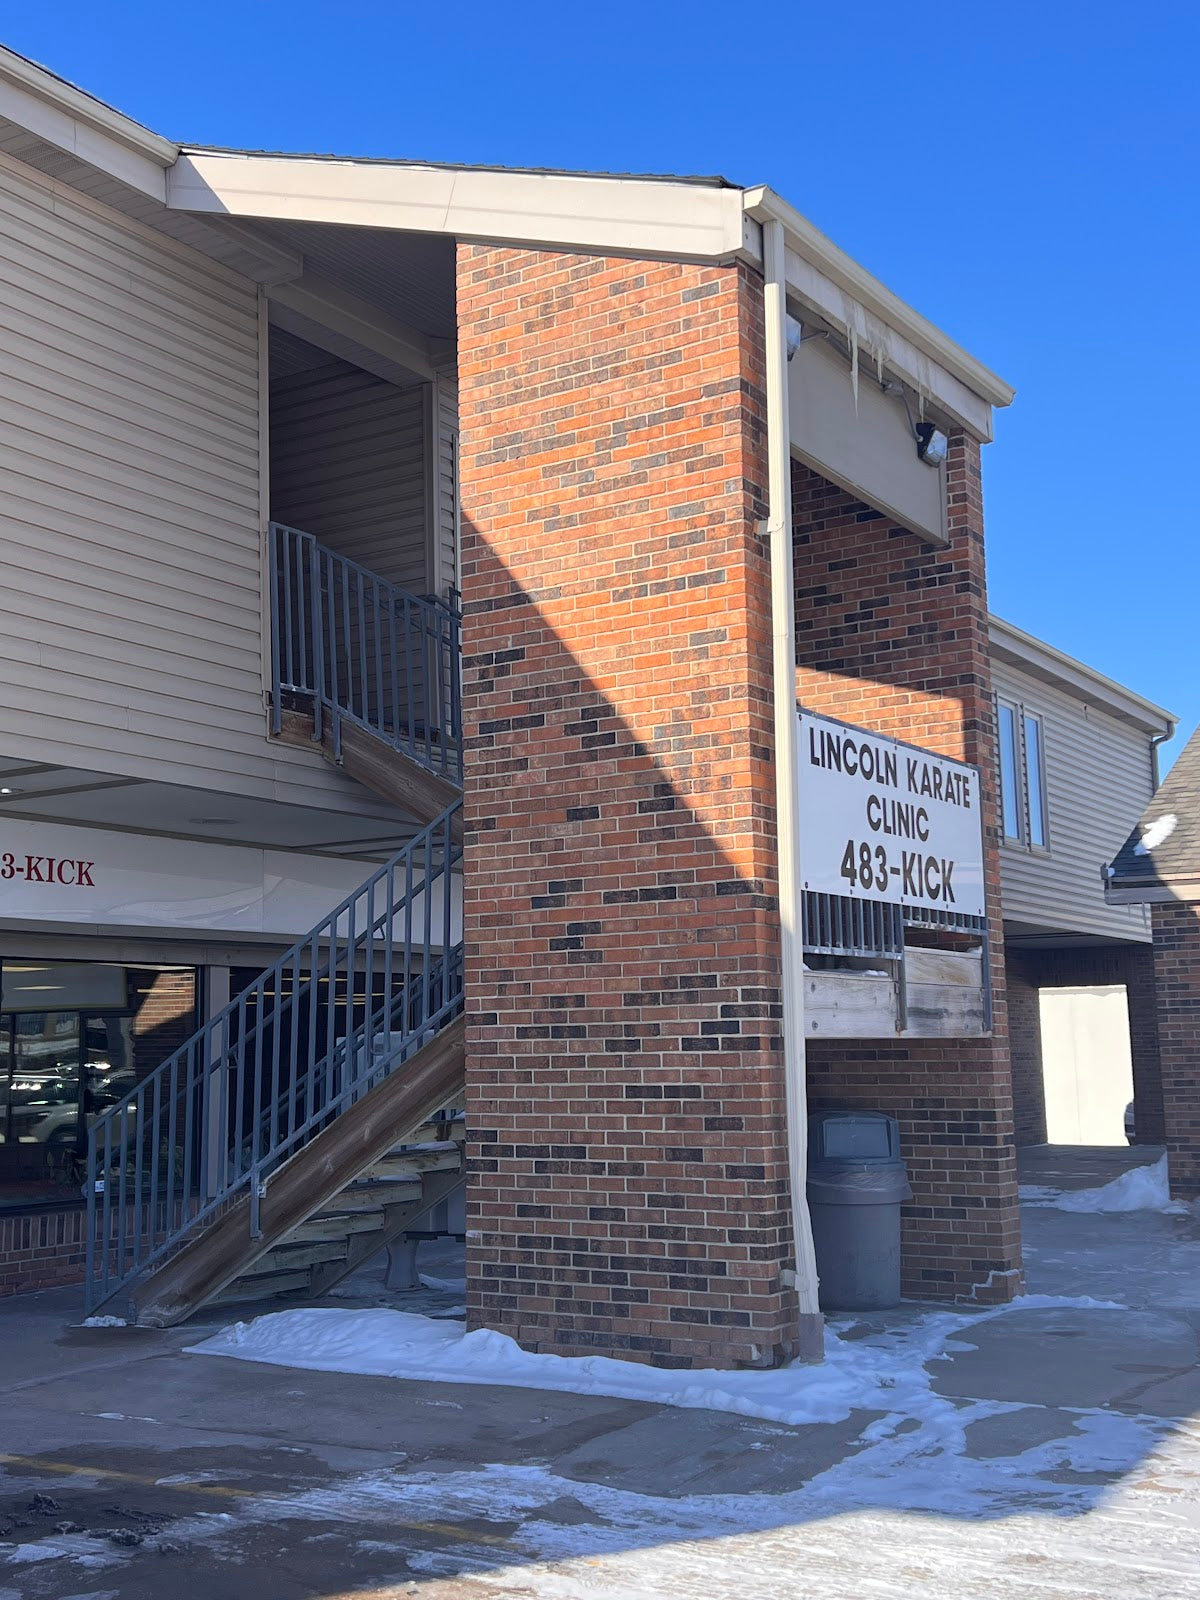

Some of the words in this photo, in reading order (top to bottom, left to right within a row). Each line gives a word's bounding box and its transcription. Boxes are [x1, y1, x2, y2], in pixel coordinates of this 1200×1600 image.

[809, 727, 898, 788] LINCOLN
[906, 757, 971, 809] KARATE
[866, 794, 930, 842] CLINIC
[1, 853, 95, 887] 3-KICK
[840, 839, 956, 903] 483-KICK
